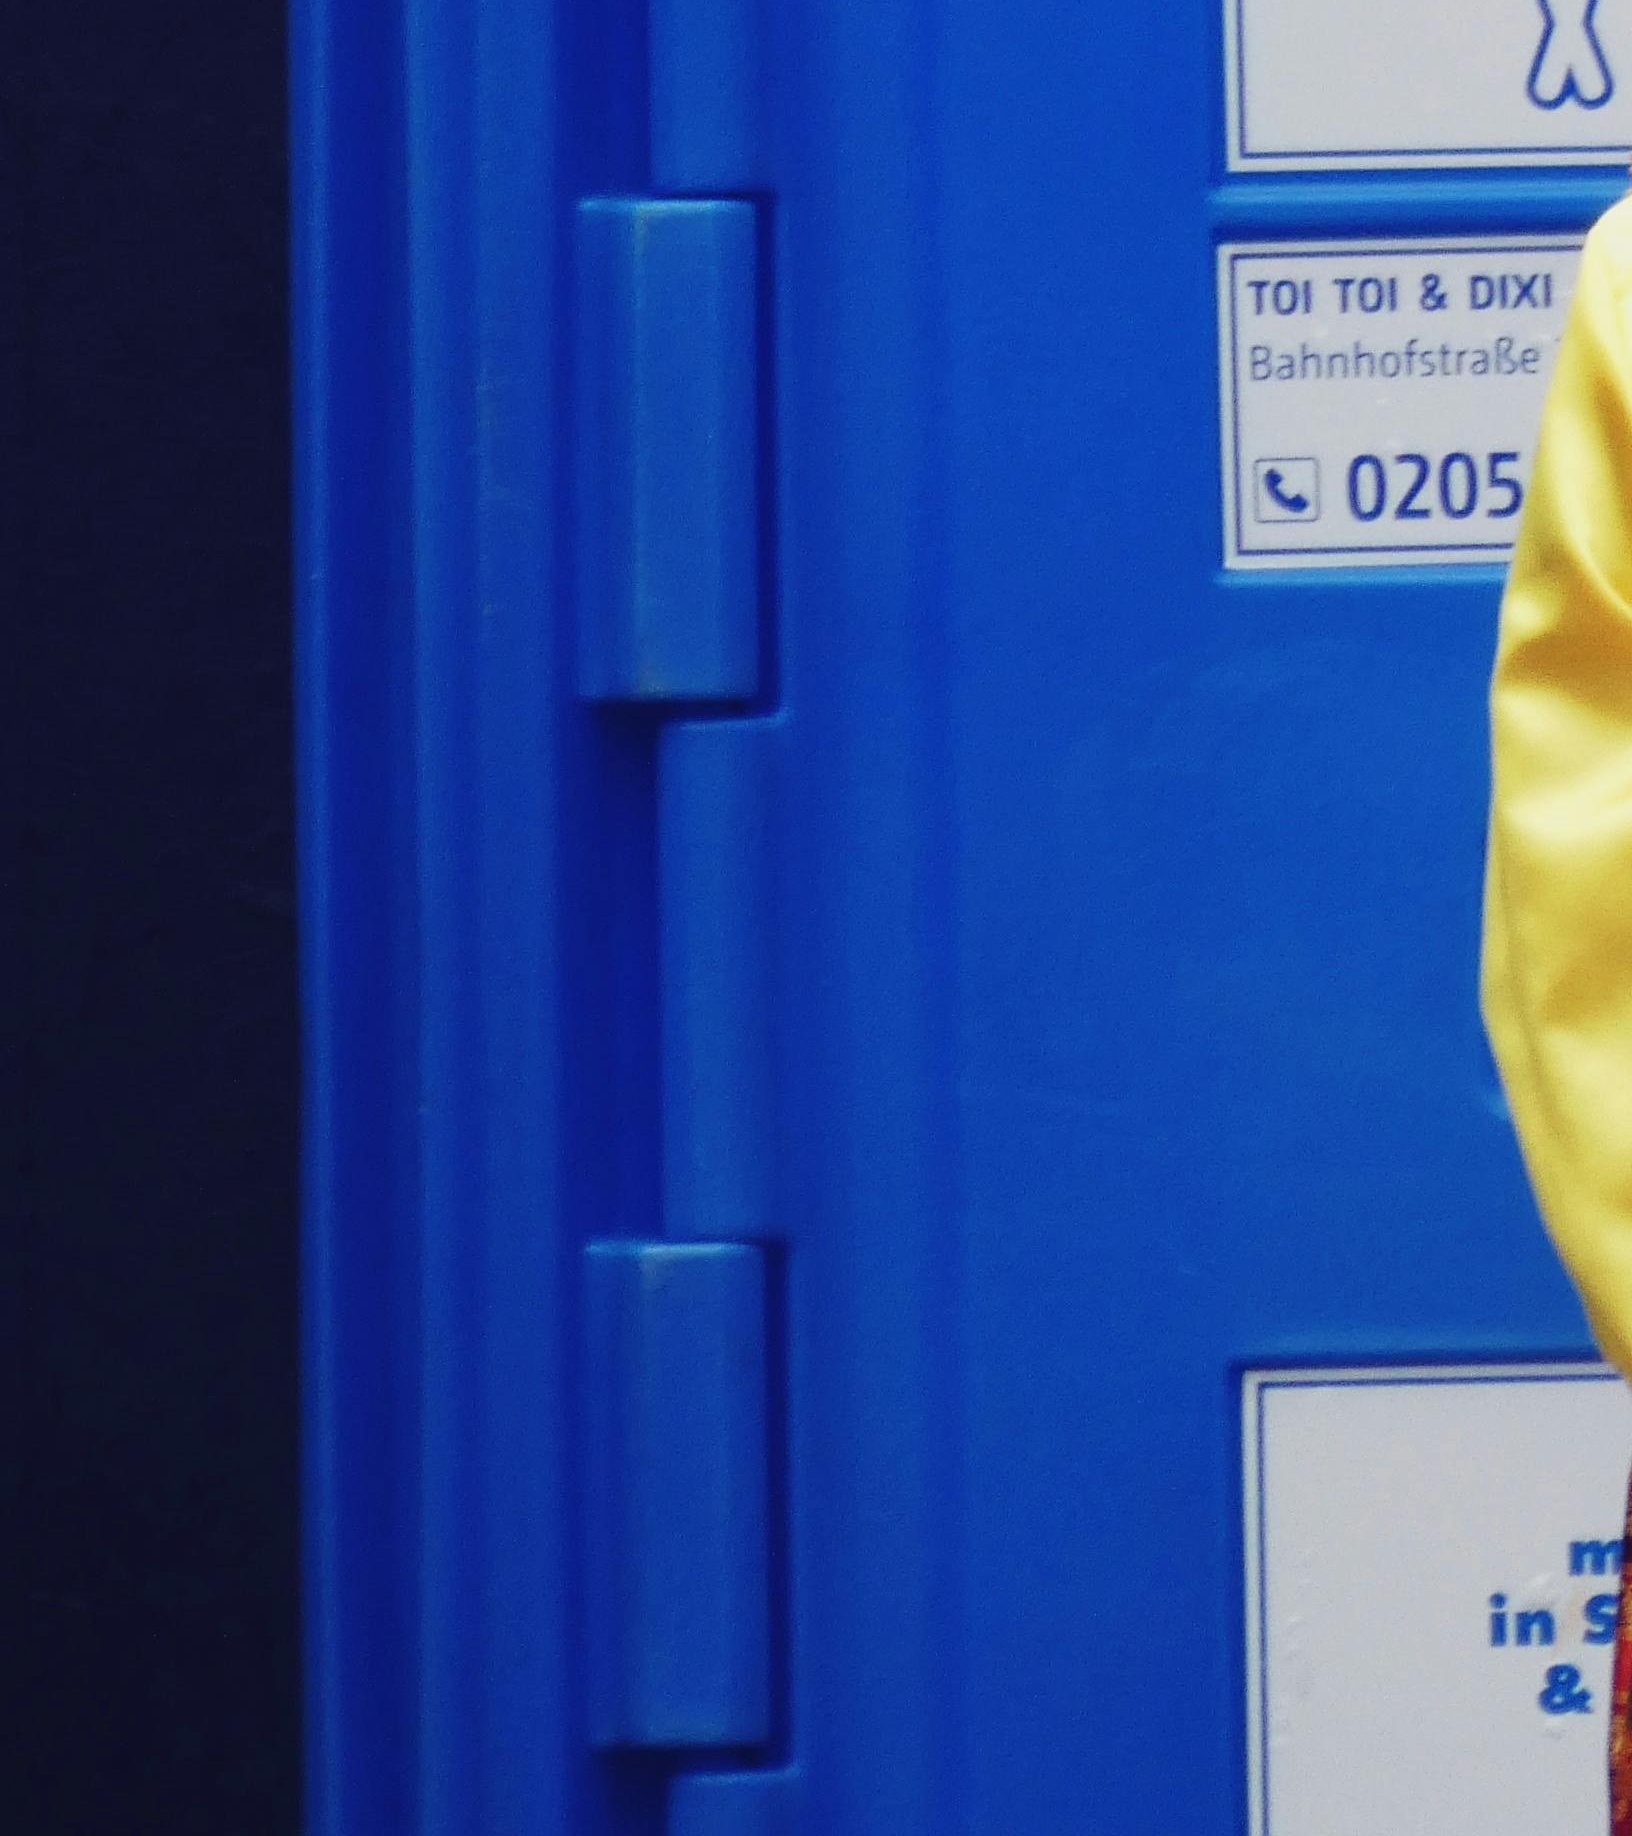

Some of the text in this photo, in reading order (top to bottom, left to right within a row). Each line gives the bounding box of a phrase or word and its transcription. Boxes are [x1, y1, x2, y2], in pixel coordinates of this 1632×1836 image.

[1247, 272, 1553, 316] TOI TOI & DIXI
[1250, 337, 1541, 381] Bahnhofstraße
[1347, 451, 1525, 522] 0205
[1490, 1593, 1555, 1646] in
[1539, 1663, 1594, 1716] &
